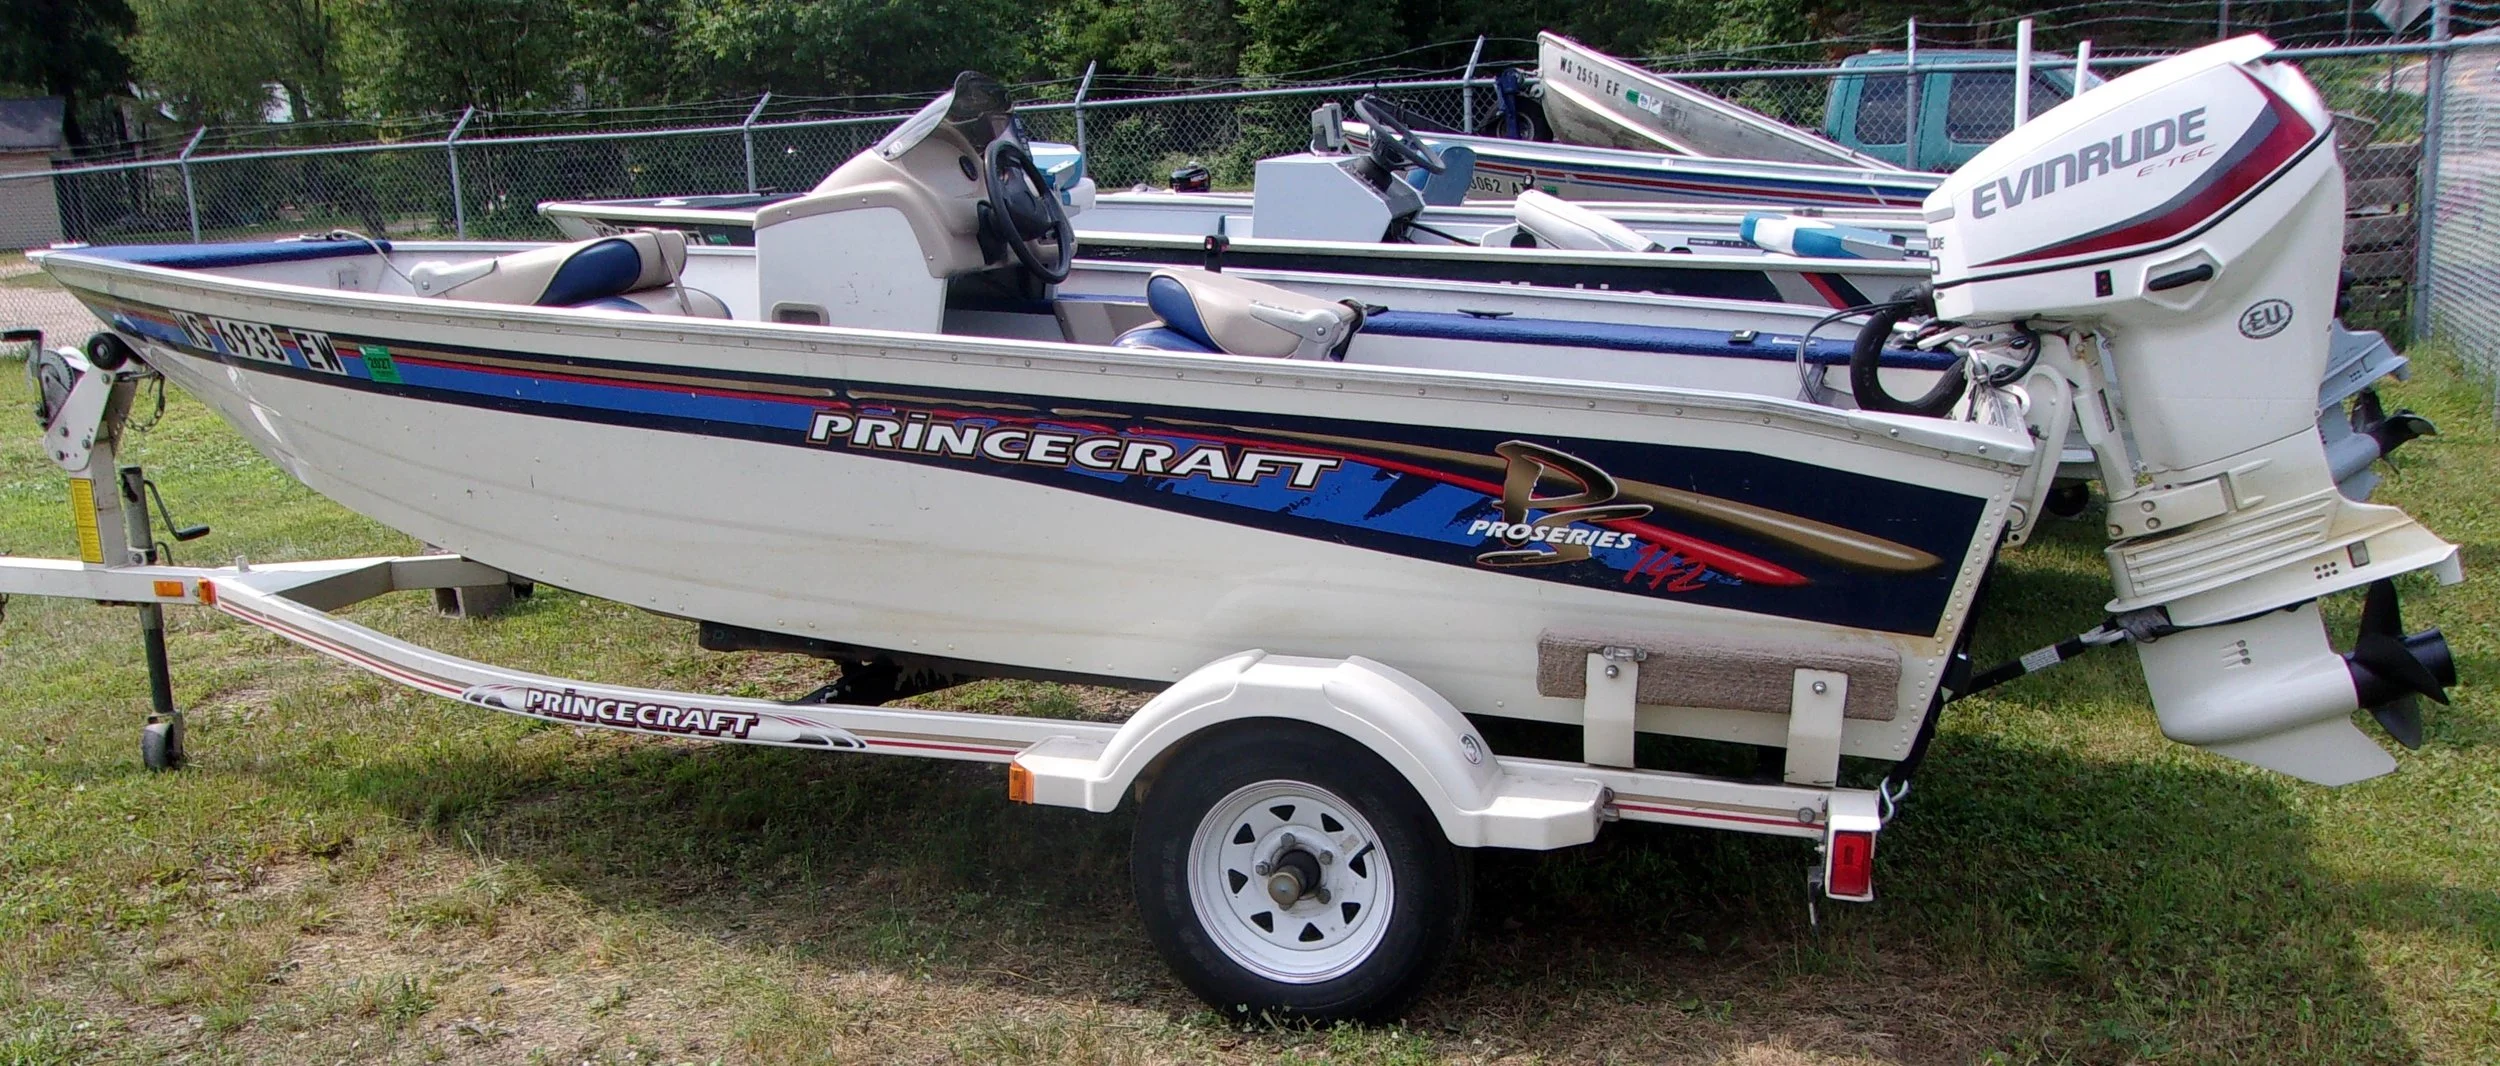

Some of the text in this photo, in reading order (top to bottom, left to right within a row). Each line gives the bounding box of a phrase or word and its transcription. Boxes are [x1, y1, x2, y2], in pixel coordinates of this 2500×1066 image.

[1560, 56, 1572, 74] WS
[1606, 79, 1620, 97] EF
[1972, 106, 2206, 220] EVINRUDE
[2136, 143, 2218, 178] E-TEC
[173, 311, 343, 372] WS 6933 EW
[809, 411, 1342, 489] PRINCECRAFT
[1467, 519, 1637, 550] PROSERIES
[1623, 543, 1708, 593] 142
[524, 689, 758, 738] PRINCECRAFT
